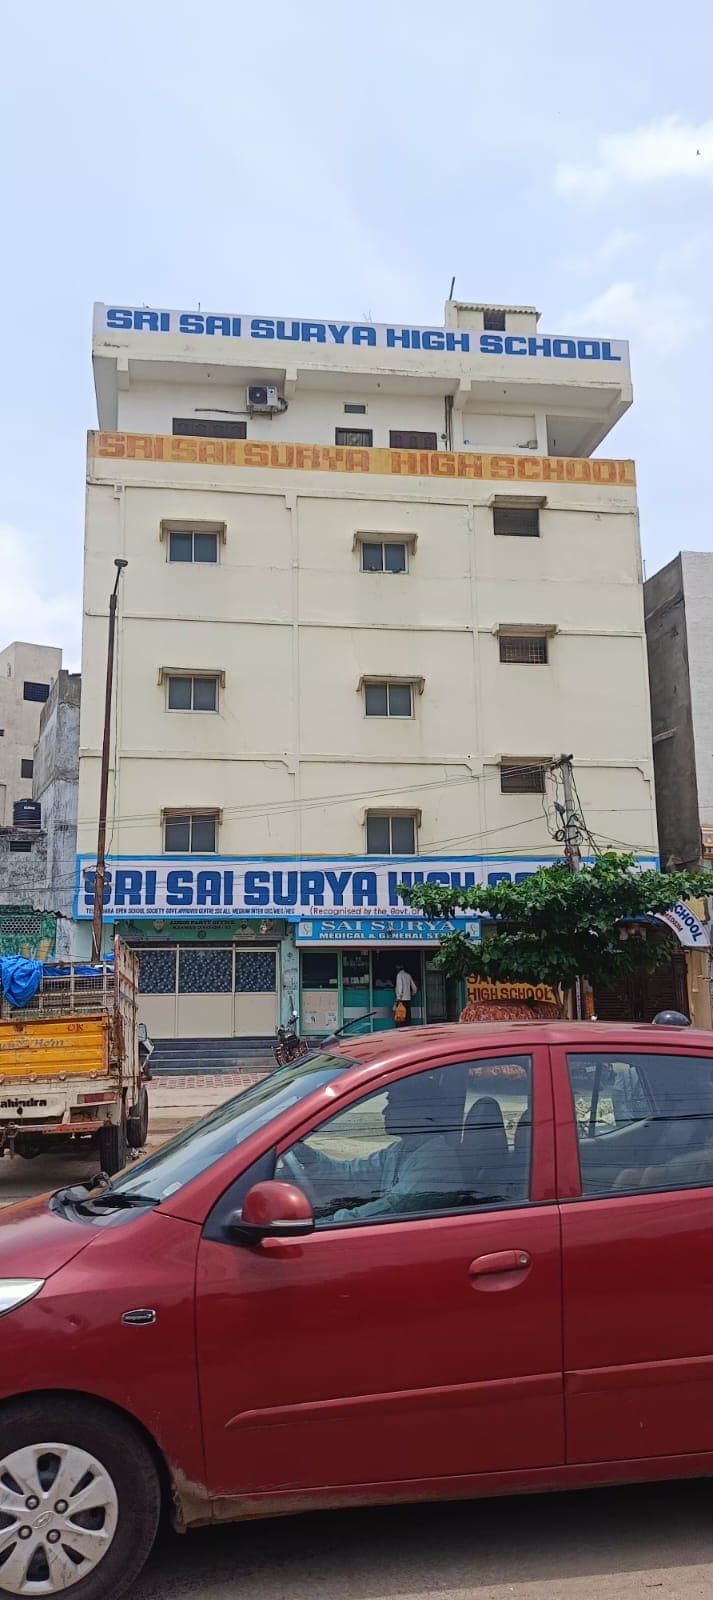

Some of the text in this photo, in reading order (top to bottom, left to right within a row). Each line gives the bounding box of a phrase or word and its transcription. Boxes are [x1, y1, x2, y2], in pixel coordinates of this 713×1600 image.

[106, 308, 621, 361] SRI SAI SURYA HIGH SCHOOL
[99, 432, 634, 483] SRI SAI SURYA HIGH SCHOOL
[84, 870, 157, 905] SRI
[166, 870, 234, 906] SAI
[243, 870, 378, 906] SURYA
[321, 920, 456, 931] SAI SURYA
[467, 987, 552, 1001] HIGH SCHOOL
[67, 1023, 84, 1032] OK
[0, 1097, 47, 1108] ahindra
